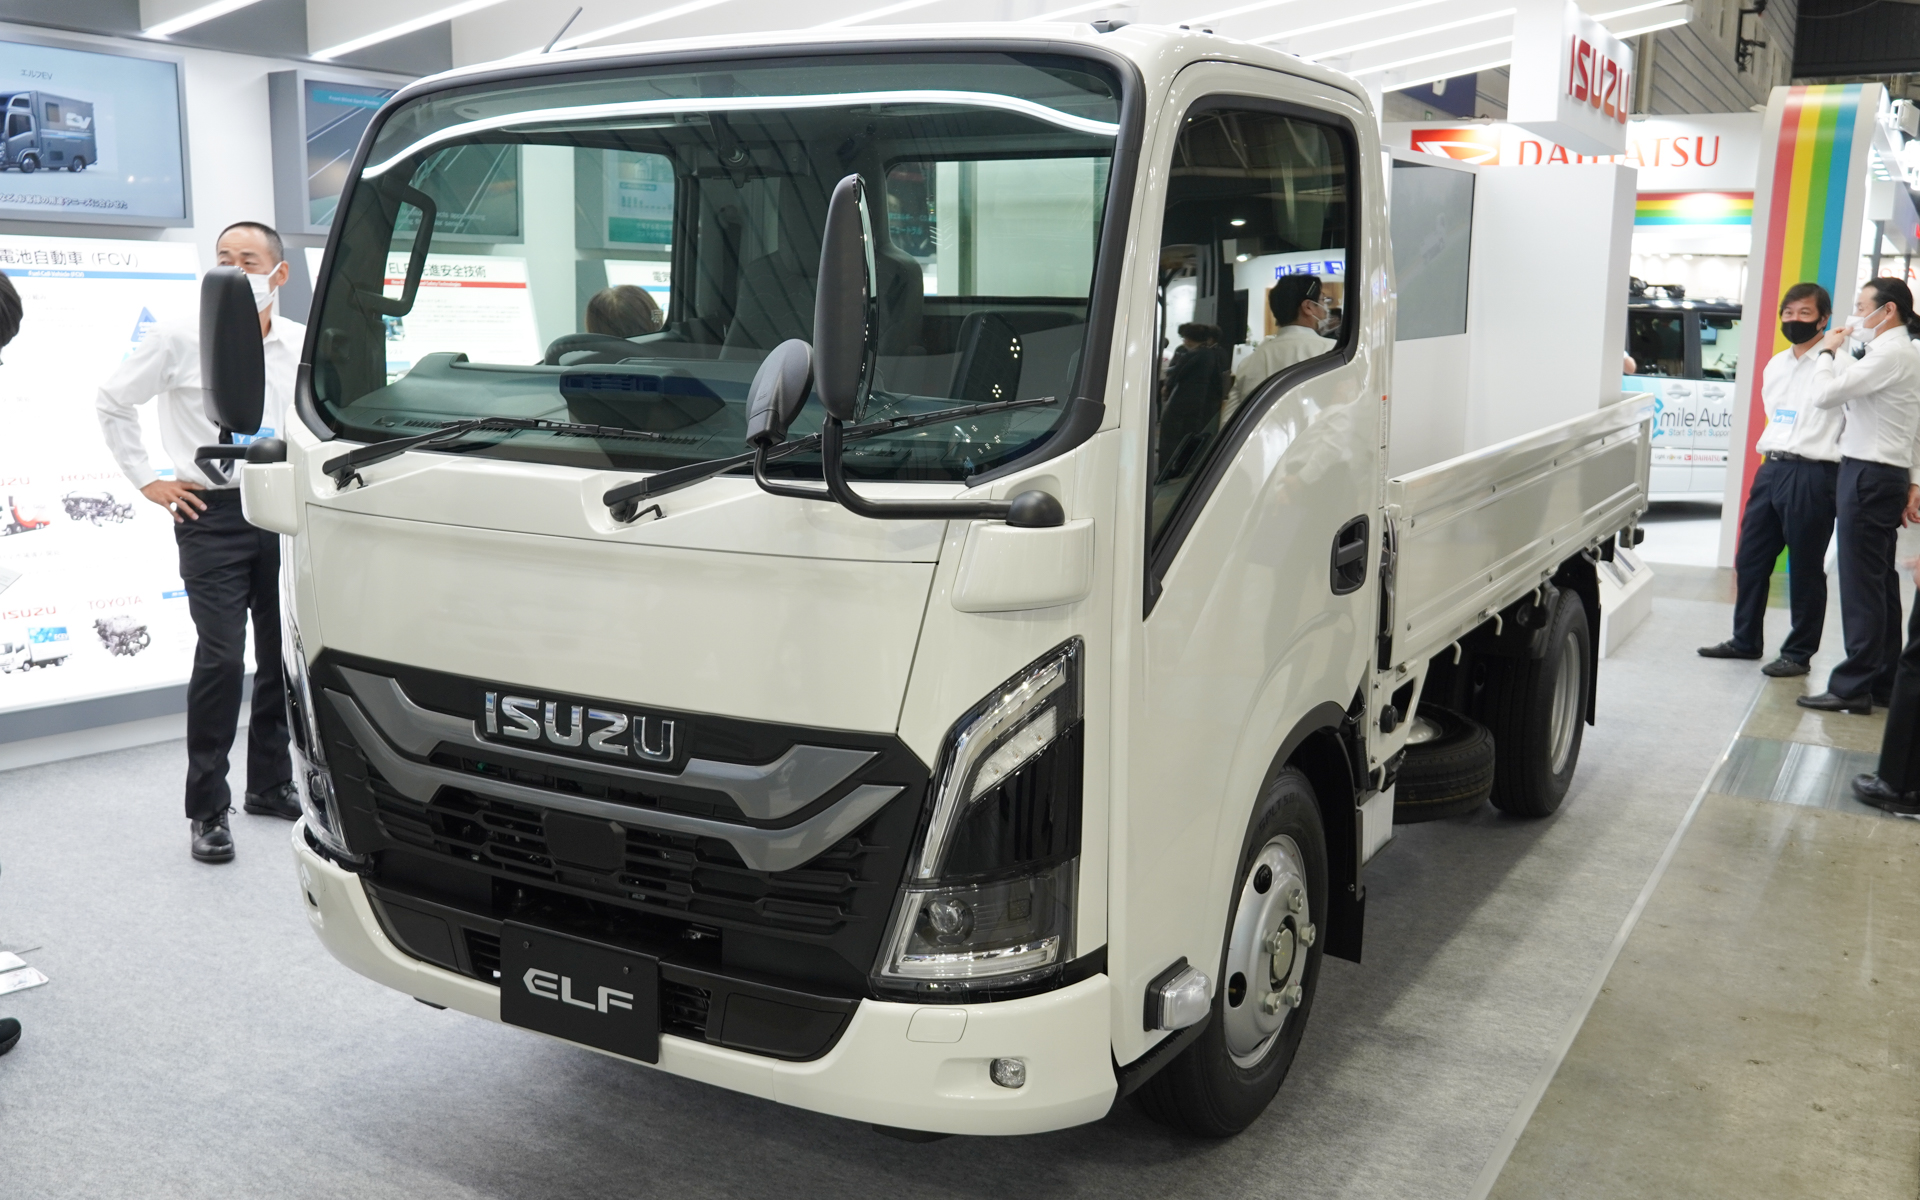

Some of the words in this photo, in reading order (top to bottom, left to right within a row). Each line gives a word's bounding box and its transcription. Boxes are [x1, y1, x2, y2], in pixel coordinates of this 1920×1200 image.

[20, 69, 53, 80] エルフEV
[1569, 34, 1630, 125] ISUZU
[1668, 428, 1685, 437] Start
[1687, 428, 1706, 437] Smart
[1693, 454, 1720, 462] DAIHATSU
[60, 472, 123, 482] HONDA
[2, 605, 58, 620] ISUZU
[87, 595, 144, 611] TOYOTA
[485, 691, 675, 763] ISUZU
[522, 967, 634, 1014] ELF
